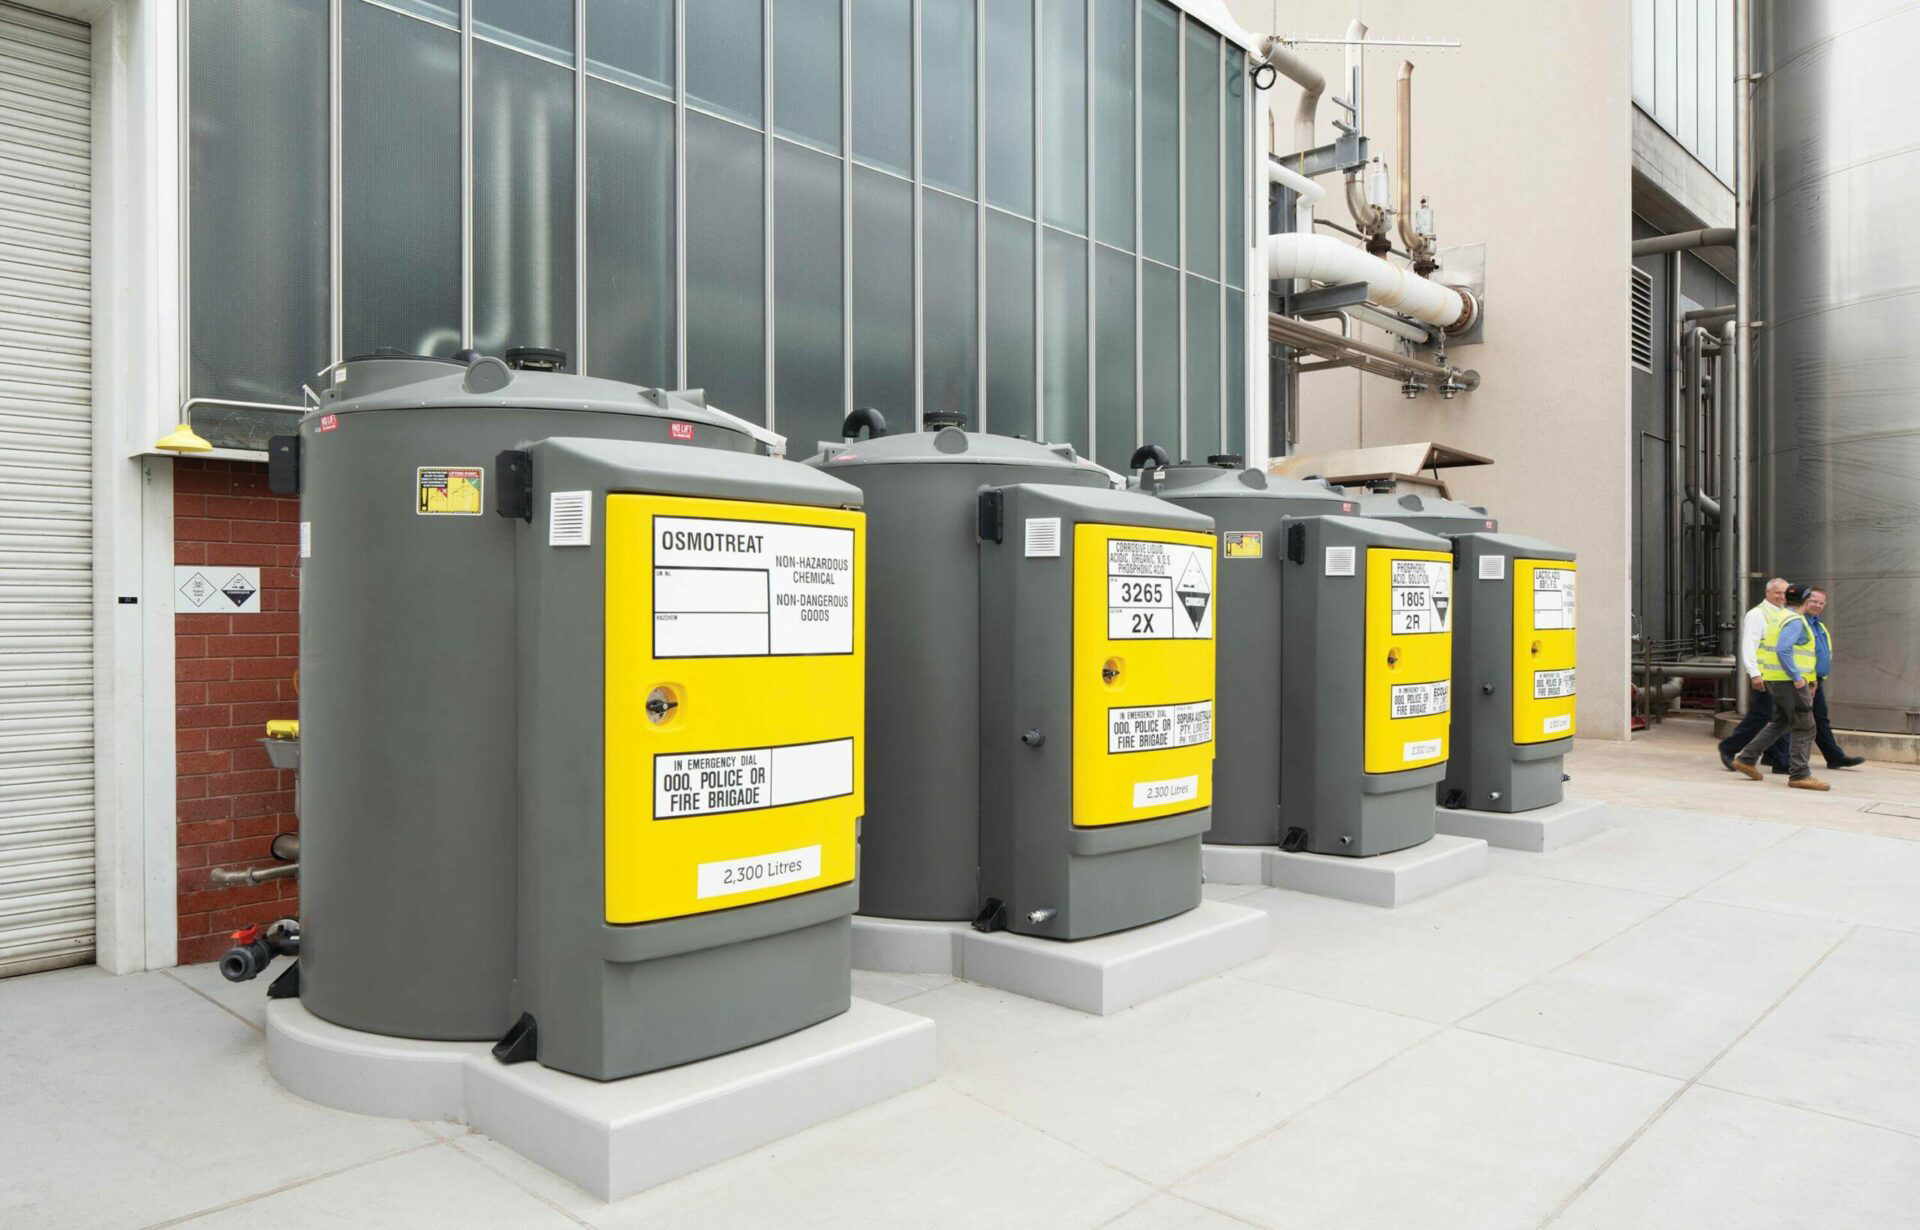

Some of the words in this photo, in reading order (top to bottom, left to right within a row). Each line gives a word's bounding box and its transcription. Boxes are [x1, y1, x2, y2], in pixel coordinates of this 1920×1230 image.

[672, 423, 680, 432] NO
[681, 424, 692, 433] LIFT
[662, 531, 764, 553] OSMOTREAT
[1116, 542, 1146, 554] CORROSIVE
[776, 555, 848, 571] NON-HAZARDOUS
[1118, 563, 1152, 574] PHOSPHONIC
[1154, 565, 1165, 575] ACID
[793, 571, 836, 585] CHEMICAL
[1122, 582, 1162, 602] 3265
[1400, 592, 1424, 607] 1805
[776, 594, 848, 608] NON-DANGEROUS
[800, 609, 830, 622] GOODS
[1132, 613, 1154, 633] 2X
[1406, 614, 1420, 630] 2R
[1407, 693, 1422, 704] POLICE
[1423, 692, 1428, 702] OR
[1127, 710, 1155, 720] EMERGENCY
[1157, 710, 1168, 718] DIAL
[1396, 704, 1408, 716] FIRE
[1410, 704, 1427, 714] BRIGADE
[1134, 720, 1159, 734] POLICE
[1162, 718, 1171, 731] OR
[1118, 736, 1135, 749] FIRE
[1140, 733, 1168, 748] BRIGADE
[674, 760, 682, 771] IN
[688, 756, 736, 770] EMERGENCY
[741, 755, 758, 766] DIAL
[701, 769, 743, 790] POLICE
[750, 767, 766, 784] OR
[1147, 786, 1170, 798] 2,300
[1170, 784, 1189, 796] Litres
[670, 792, 700, 812] FIRE
[708, 787, 760, 808] BRIGADE
[724, 864, 764, 885] 2,300
[768, 860, 802, 877] Litres
